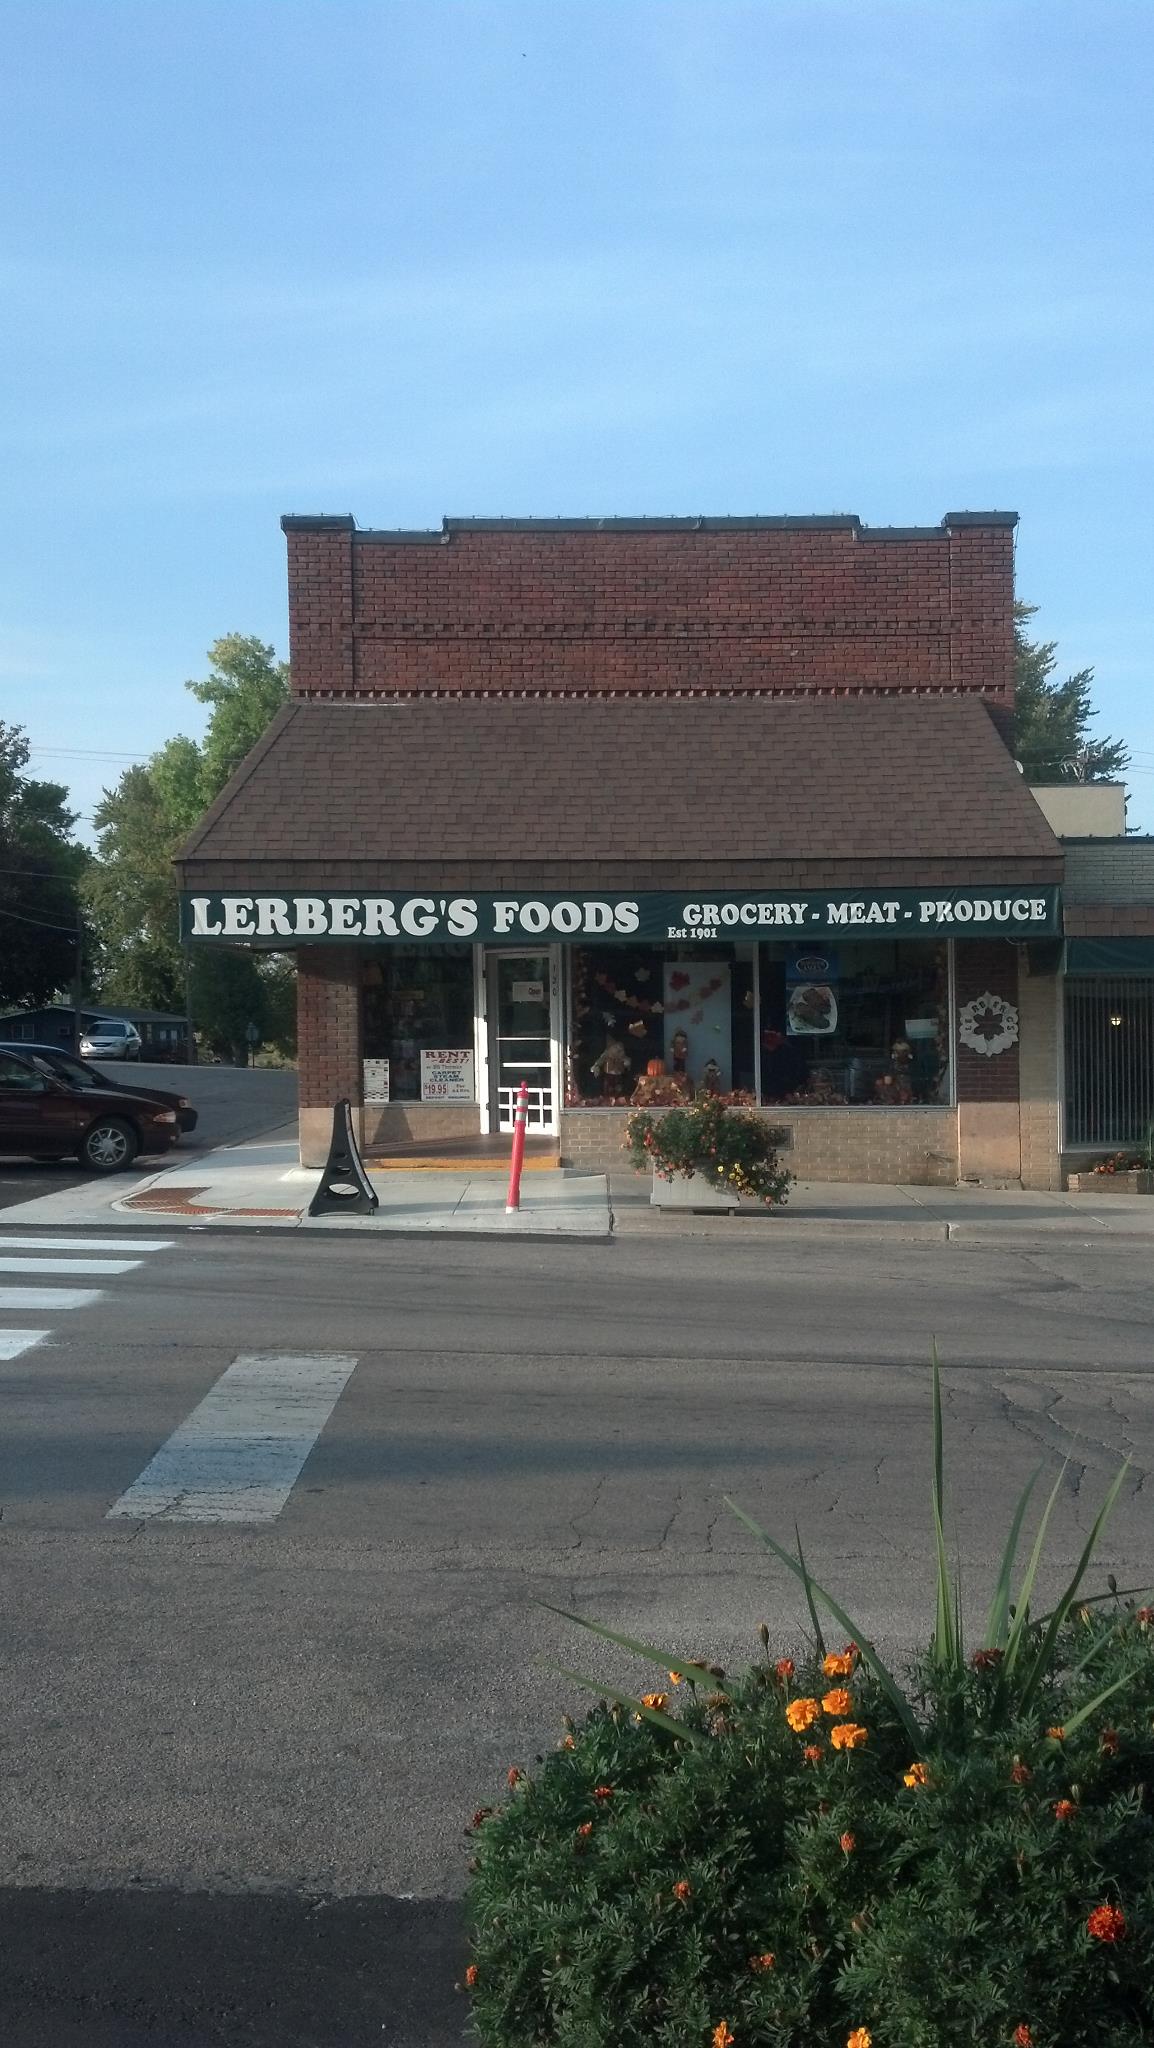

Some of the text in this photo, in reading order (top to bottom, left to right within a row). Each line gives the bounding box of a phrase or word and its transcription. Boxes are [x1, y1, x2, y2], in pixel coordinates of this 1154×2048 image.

[190, 897, 640, 937] LERBERG'S FOODS
[682, 903, 809, 926] GROCERY
[826, 901, 901, 925] MEAT
[918, 898, 1047, 923] PRODUCE
[667, 926, 718, 940] Est 1901
[425, 1051, 471, 1059] RENT
